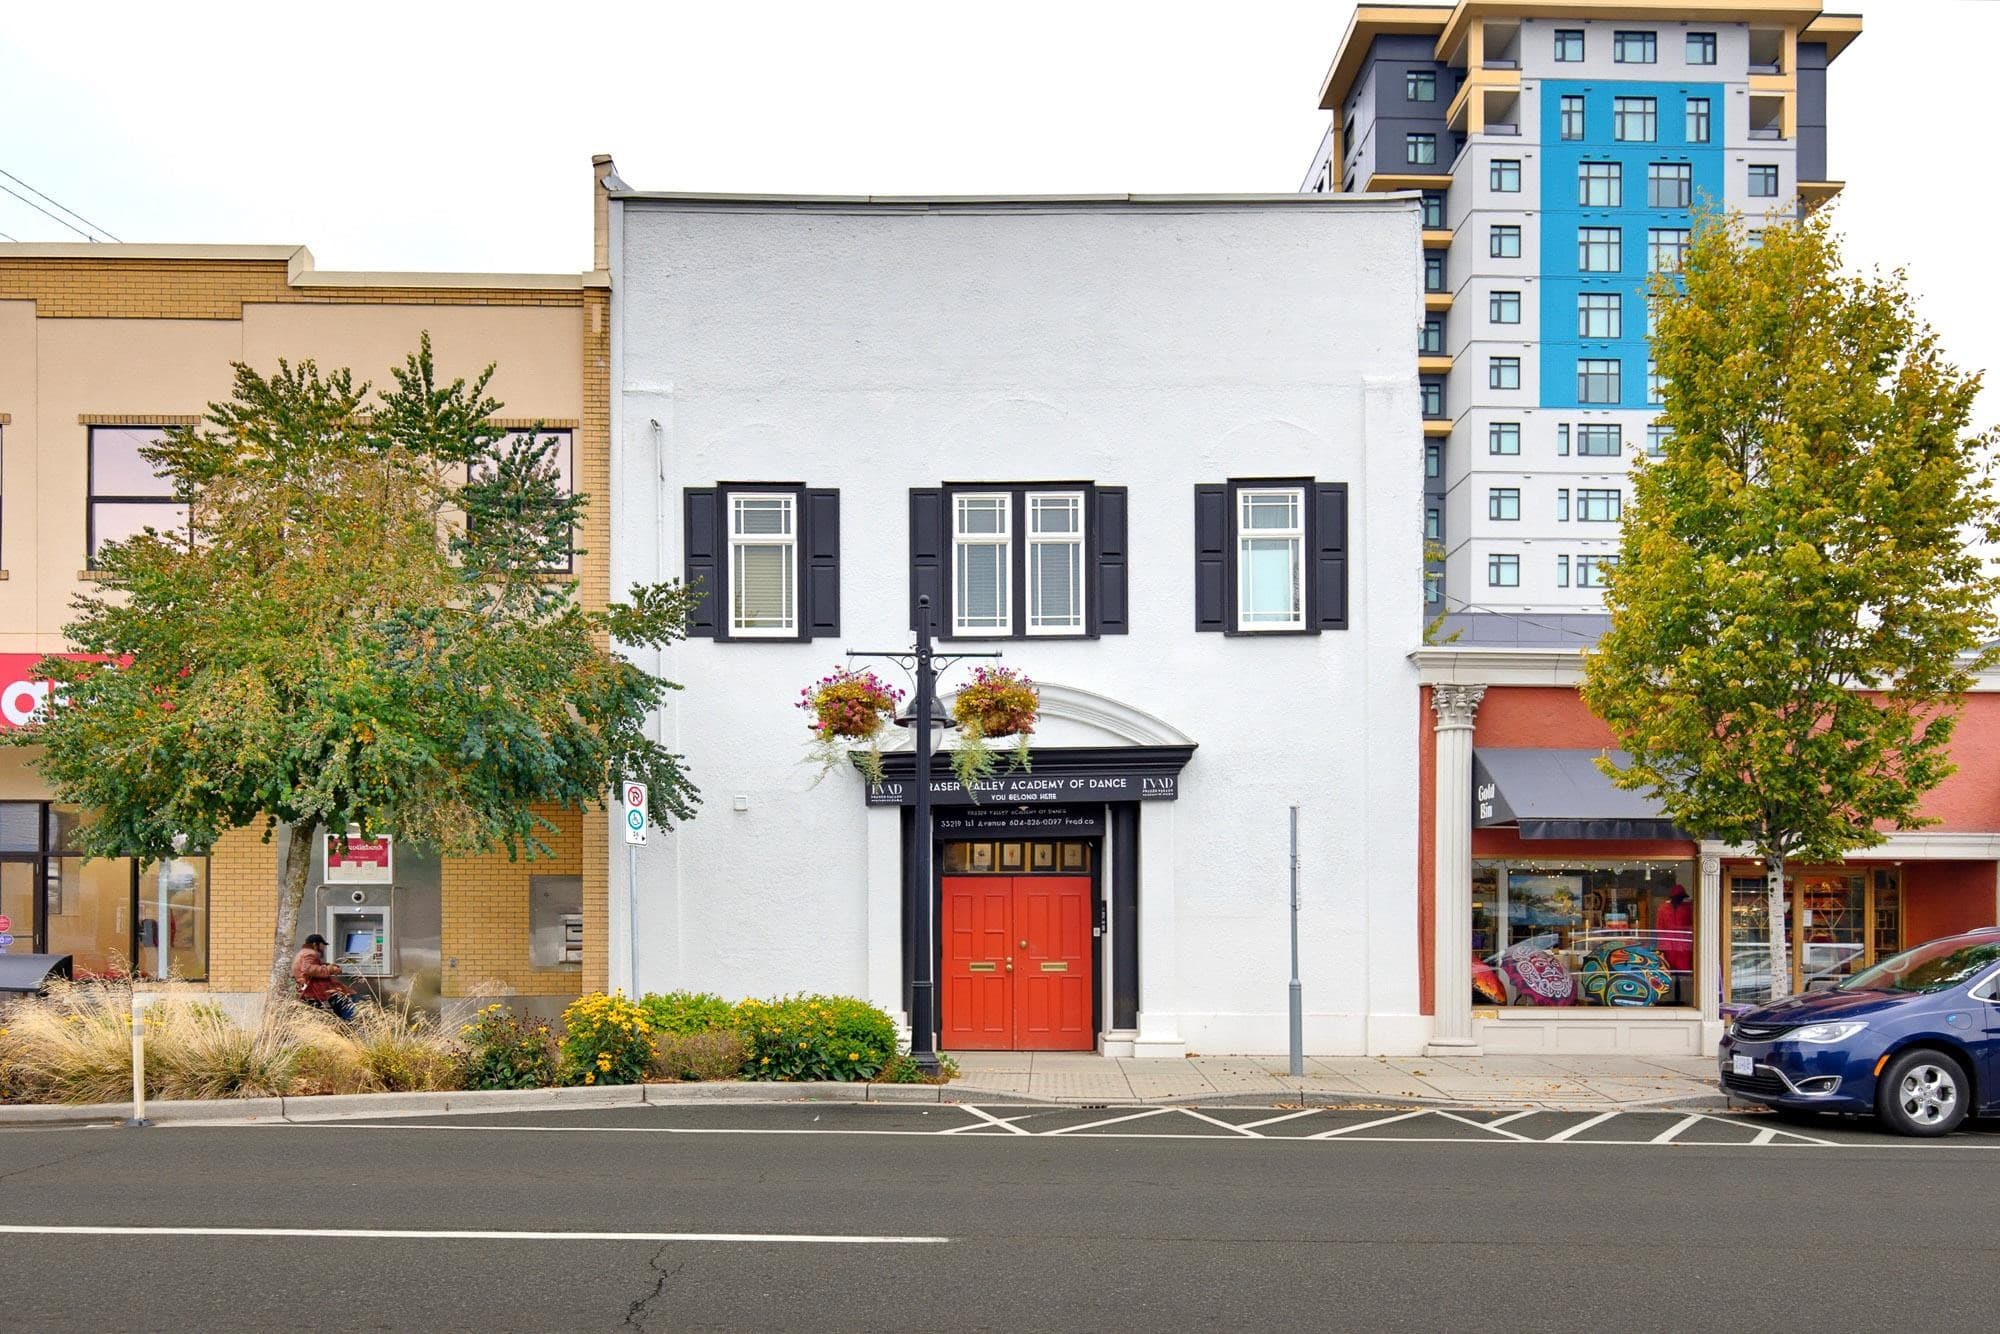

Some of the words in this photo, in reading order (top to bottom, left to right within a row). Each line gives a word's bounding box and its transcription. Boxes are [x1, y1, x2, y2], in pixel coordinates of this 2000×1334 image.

[1010, 779, 1064, 790] ACADEMY
[1069, 779, 1085, 789] OF
[1089, 778, 1127, 788] DANCE
[1008, 793, 1037, 801] BELONG
[1478, 783, 1495, 801] Gold
[1480, 802, 1493, 819] Bin
